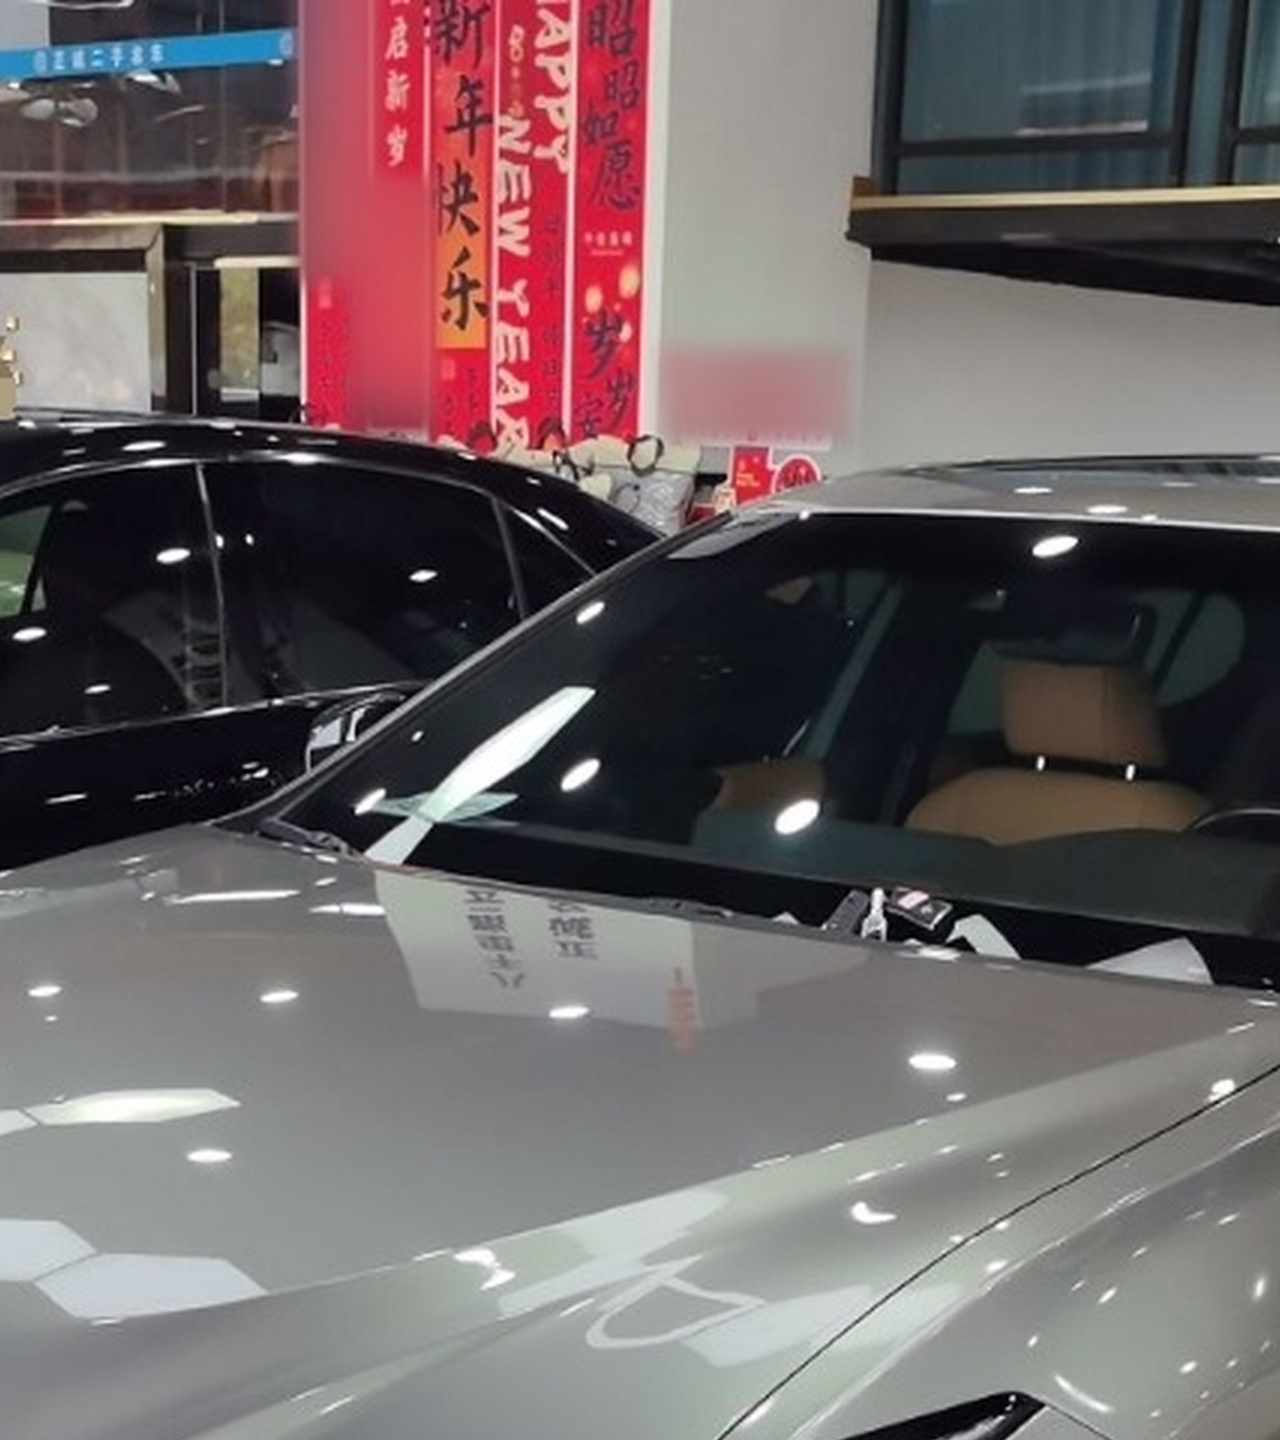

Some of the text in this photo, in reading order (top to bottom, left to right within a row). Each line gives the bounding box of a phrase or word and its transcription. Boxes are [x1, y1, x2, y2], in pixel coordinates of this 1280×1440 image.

[385, 0, 411, 167] 启新岁
[433, 0, 491, 331] 新年快乐
[534, 0, 572, 174] APPY
[584, 0, 641, 212] 昭昭如愿
[497, 114, 532, 257] NEW
[496, 279, 530, 452] YEAR
